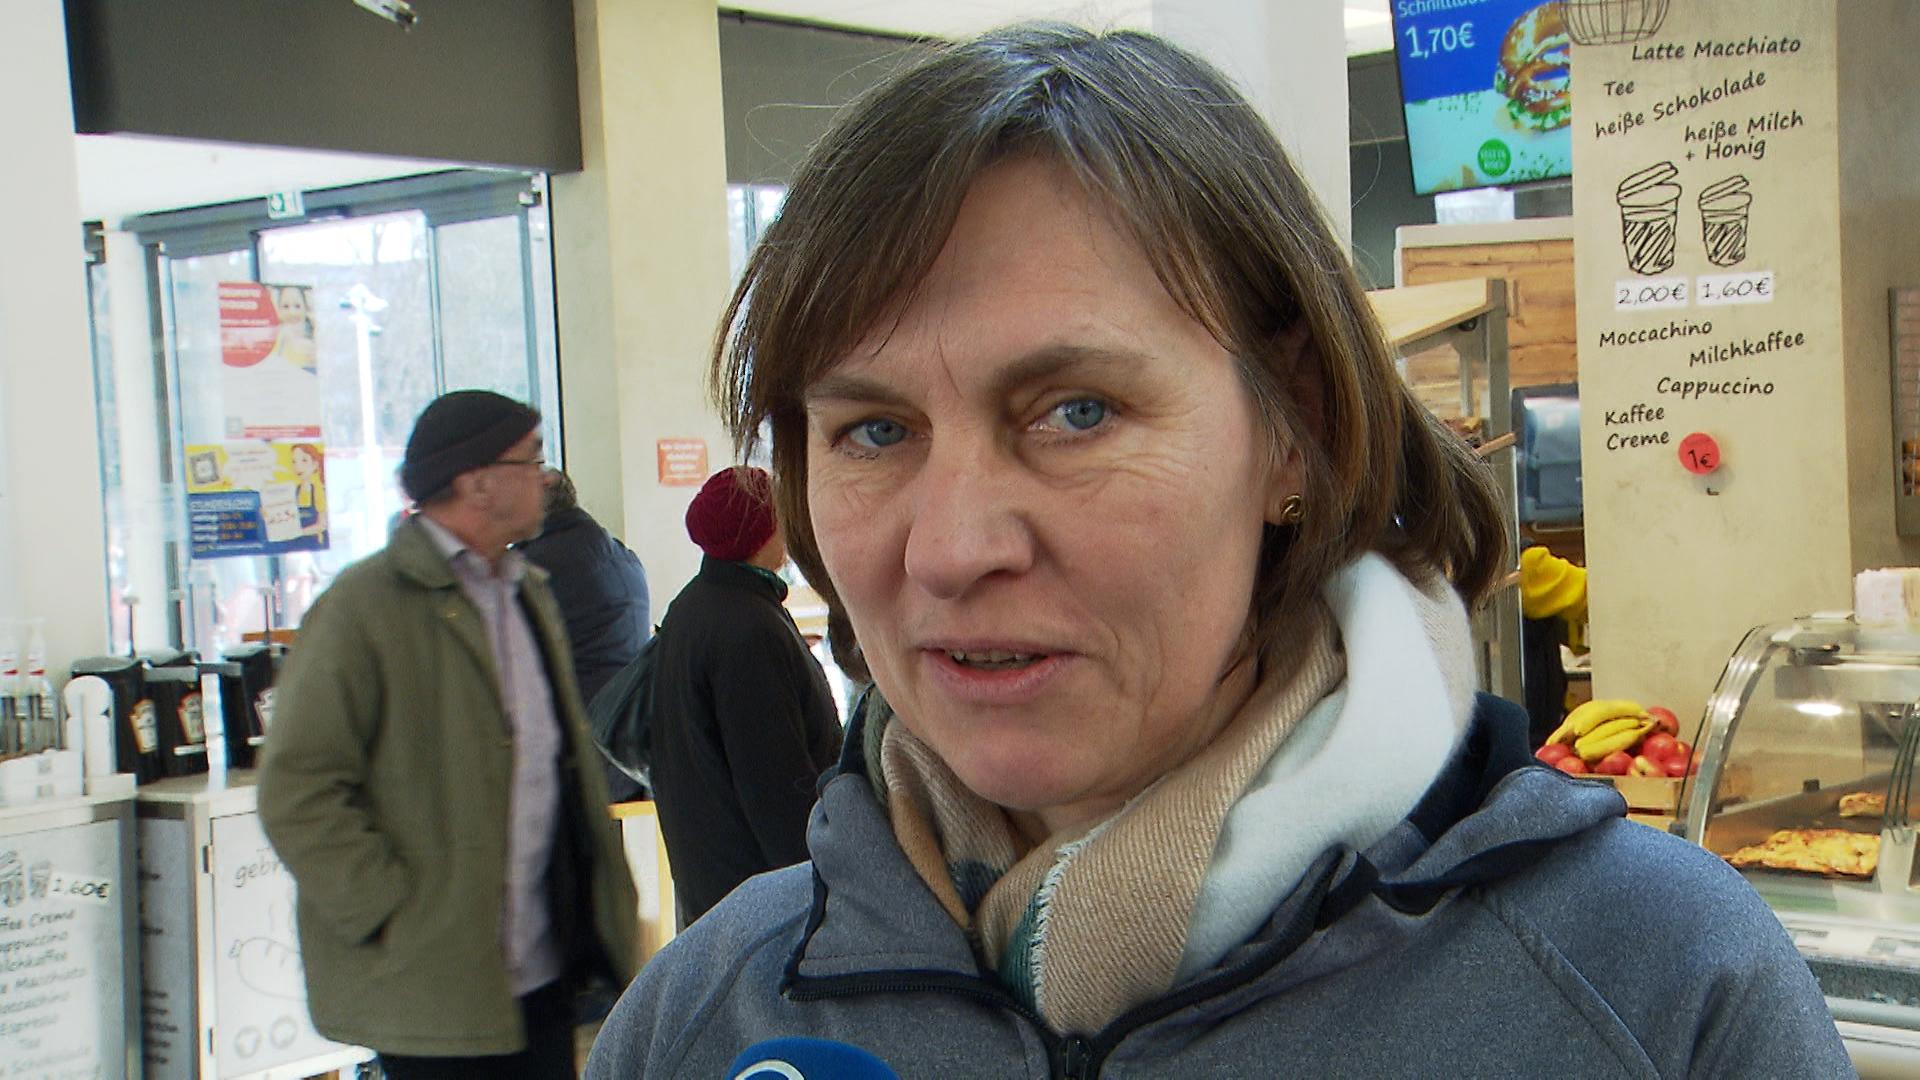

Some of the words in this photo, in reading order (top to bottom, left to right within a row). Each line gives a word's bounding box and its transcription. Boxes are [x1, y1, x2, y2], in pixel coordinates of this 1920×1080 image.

[1405, 22, 1475, 59] 1,70€
[1632, 41, 1685, 61] Latte
[1693, 36, 1801, 58] Macchiato
[1603, 81, 1634, 96] Tee
[1595, 112, 1645, 138] heiße
[1652, 69, 1767, 121] Schokolade
[1684, 120, 1738, 143] heiße
[1746, 109, 1804, 134] Milch
[1685, 150, 1696, 162] +
[1705, 135, 1767, 160] Honig
[1618, 283, 1685, 305] 2,00€
[1703, 277, 1770, 299] 1,60€
[1599, 319, 1713, 348] Moccachino
[1688, 330, 1805, 367] Milchkaffee
[1656, 376, 1775, 400] Cappuccino
[1604, 403, 1665, 427] Kaffee
[1606, 429, 1670, 452] Creme
